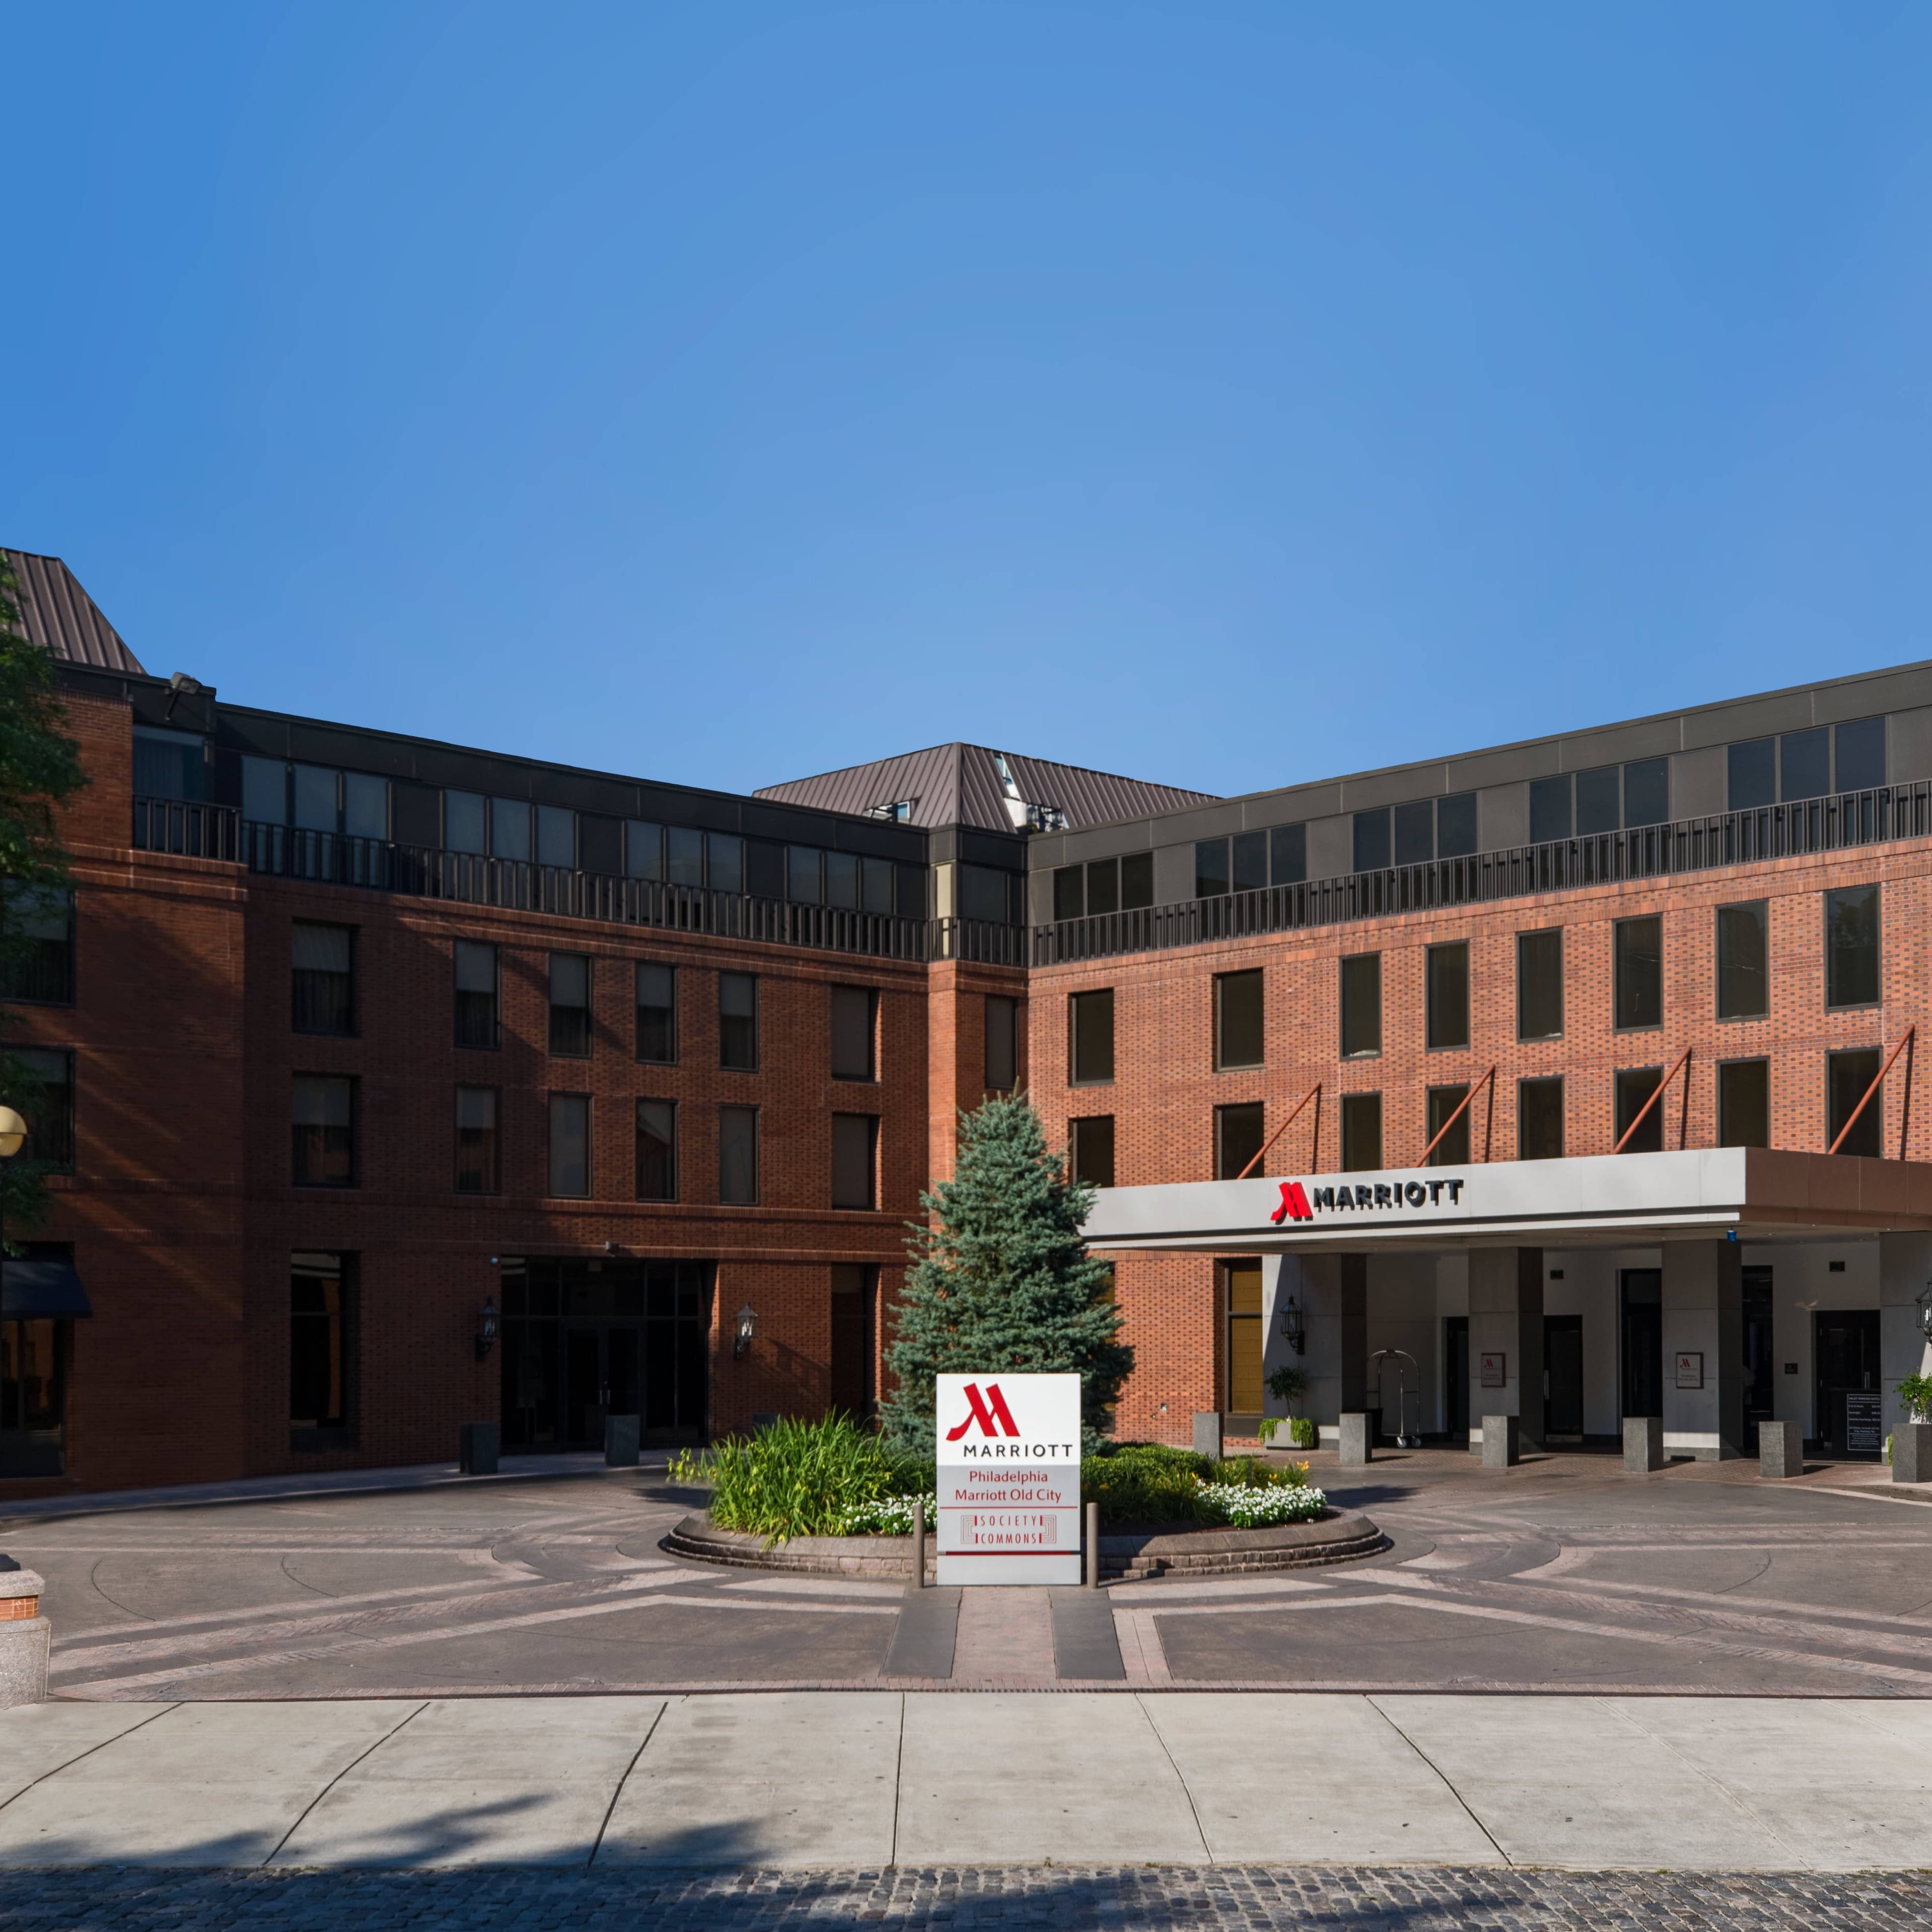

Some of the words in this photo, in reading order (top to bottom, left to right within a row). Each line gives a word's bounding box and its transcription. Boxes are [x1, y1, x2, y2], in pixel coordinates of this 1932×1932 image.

[1314, 1179, 1464, 1210] MARRIOTT
[963, 1444, 1073, 1458] MARRIOTT
[970, 1470, 1049, 1485] Philadelphia
[955, 1489, 1007, 1501] Marriott
[1010, 1489, 1033, 1501] Old
[1036, 1489, 1062, 1503] City
[980, 1515, 1037, 1526] SOCIETY
[981, 1533, 1037, 1544] COMMONS
